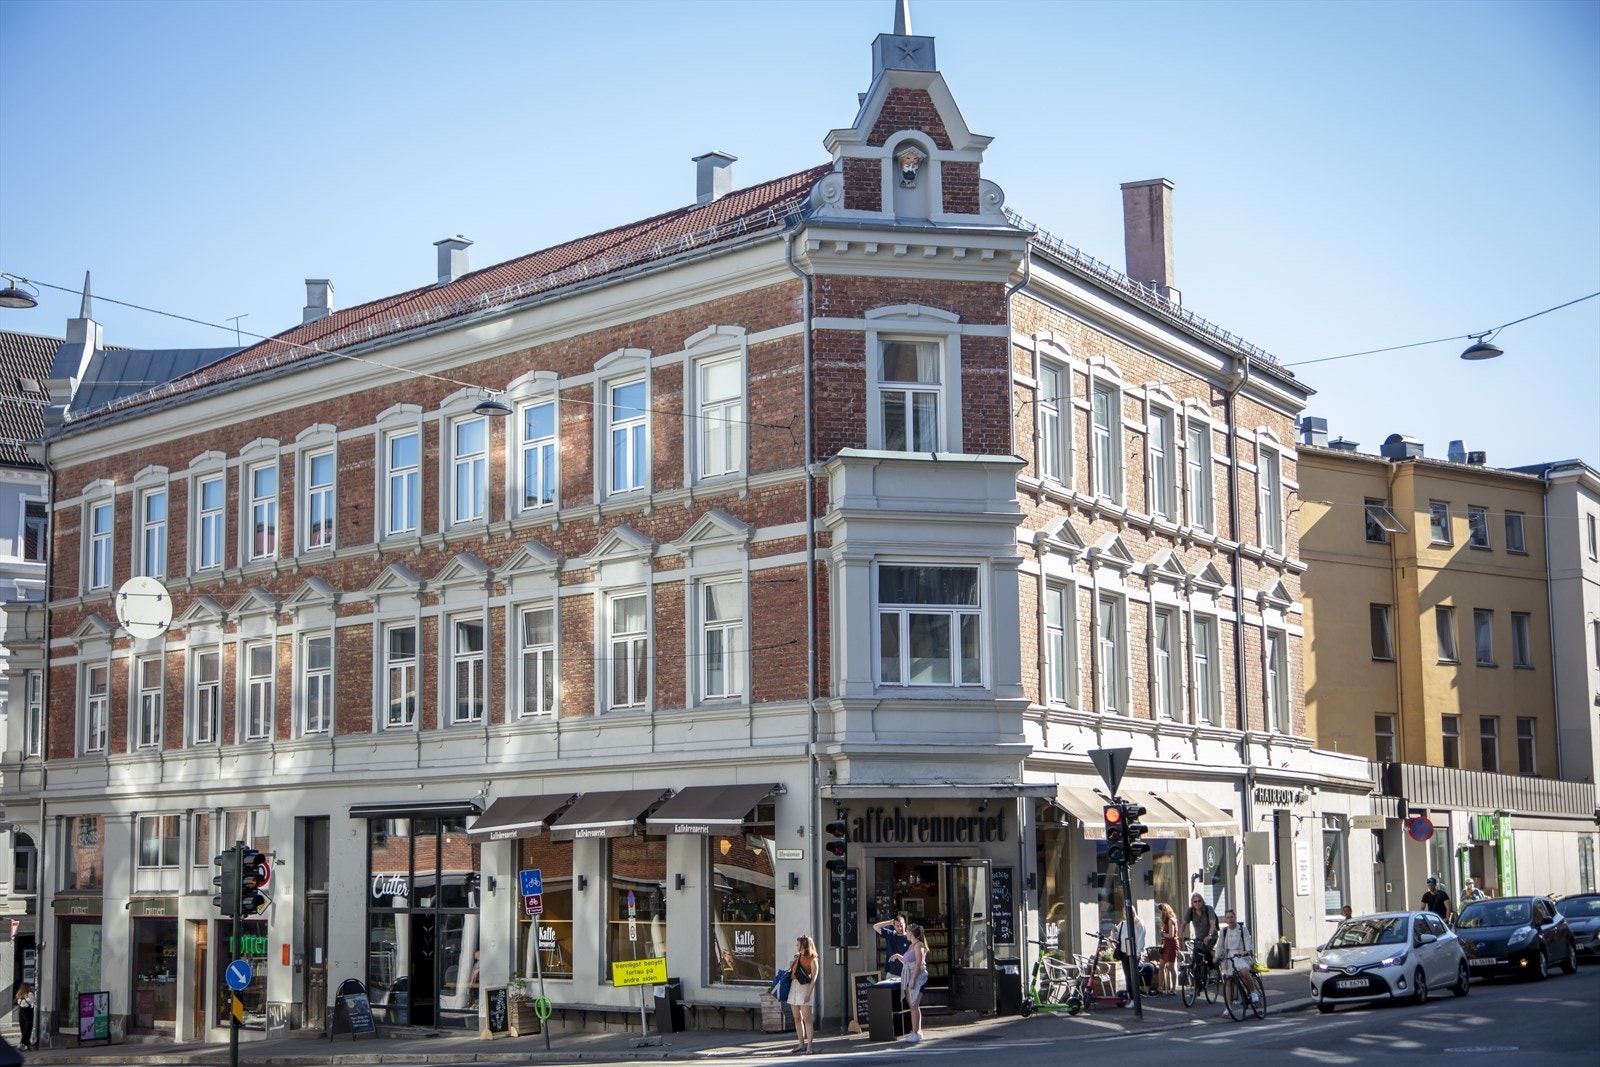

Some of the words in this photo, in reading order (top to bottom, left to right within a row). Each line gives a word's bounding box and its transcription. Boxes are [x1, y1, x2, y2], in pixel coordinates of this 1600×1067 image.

[675, 824, 709, 833] Kaffebrenneriet
[372, 873, 410, 899] Cutter
[538, 926, 556, 940] Kaffe
[735, 930, 755, 945] Kaffe
[615, 961, 641, 969] Vennligst
[644, 959, 663, 967] benytt
